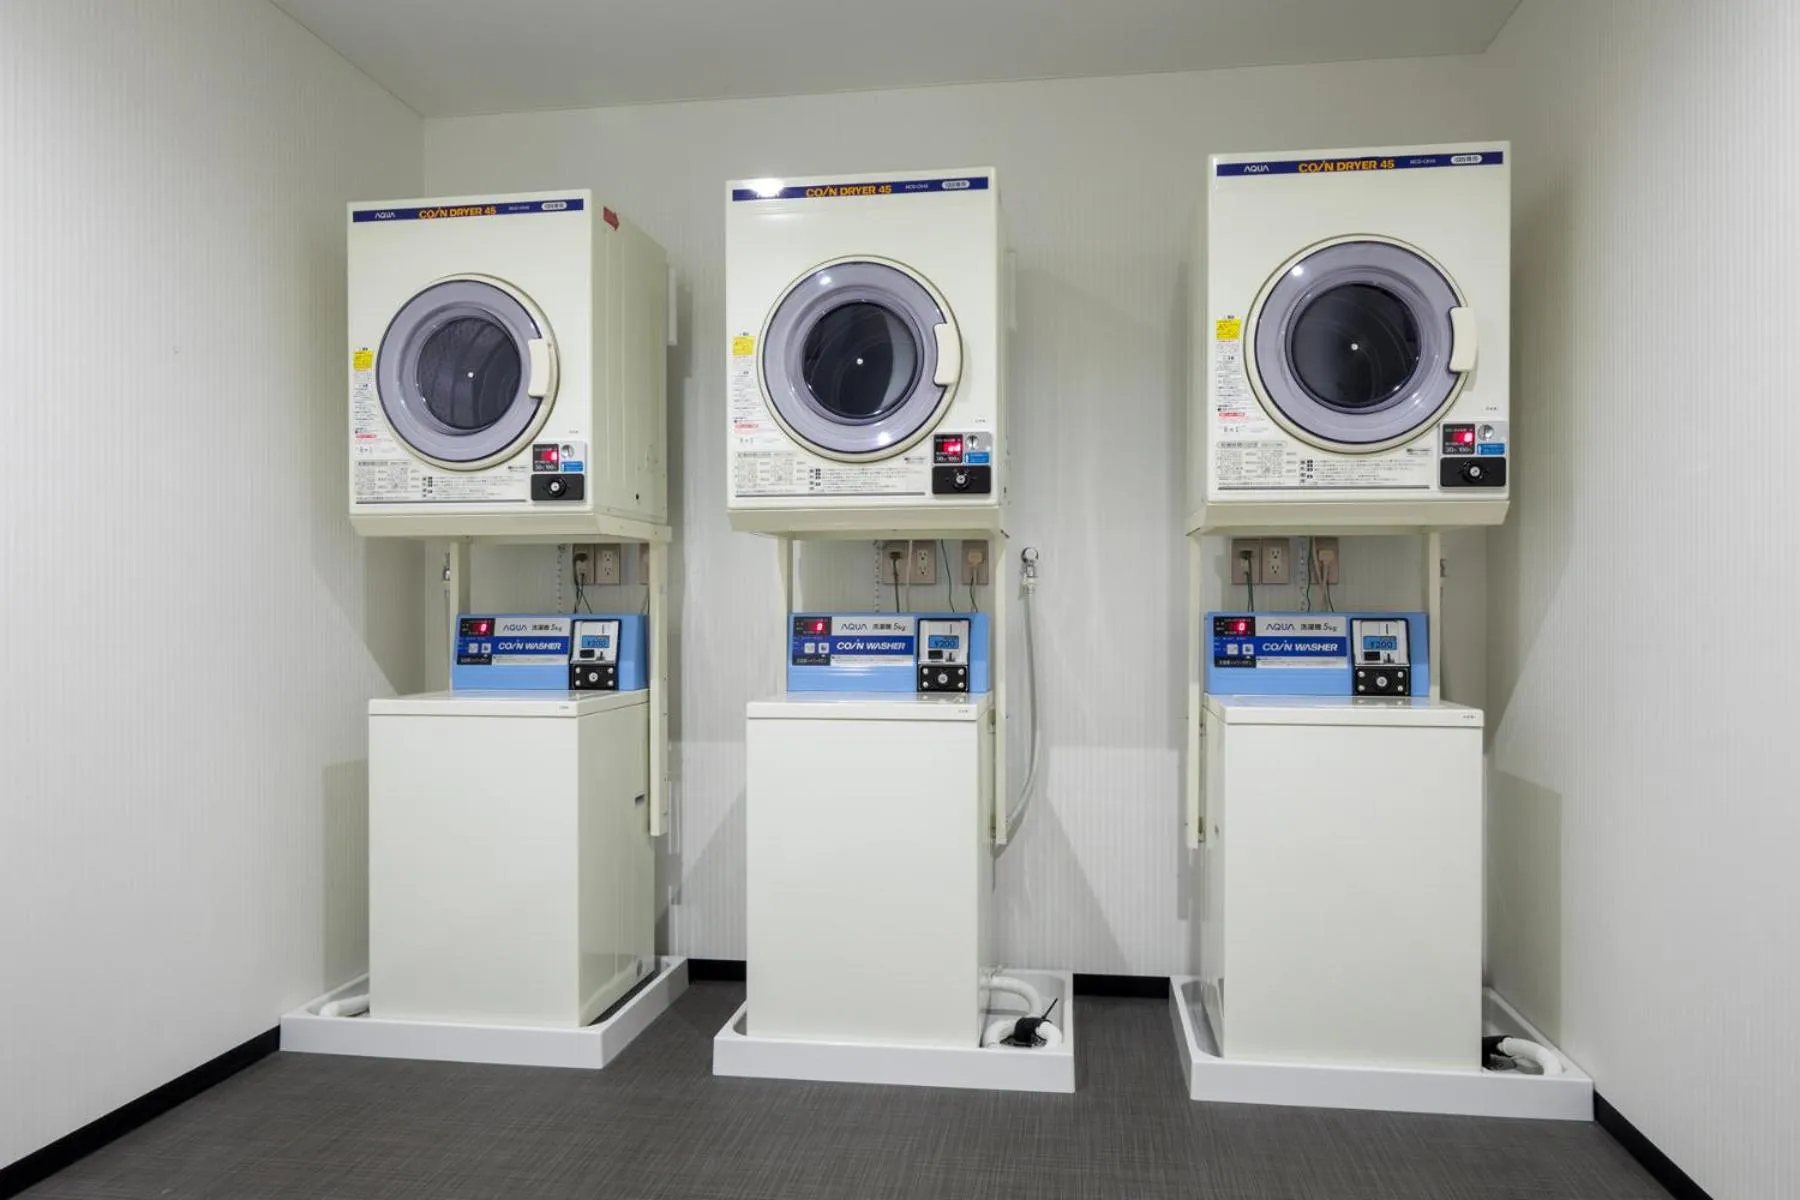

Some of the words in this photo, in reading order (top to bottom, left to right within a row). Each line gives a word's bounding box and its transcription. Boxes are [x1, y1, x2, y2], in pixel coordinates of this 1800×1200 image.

[1243, 164, 1270, 173] AQUA
[1336, 159, 1377, 172] DRYER
[1380, 159, 1395, 170] 45
[839, 185, 876, 196] DRYER
[878, 184, 893, 194] 45
[374, 211, 396, 219] AQUA
[449, 206, 483, 217] DRYER
[483, 205, 497, 215] 45
[502, 623, 528, 632] AQUA
[550, 624, 563, 632] 5kg
[840, 623, 868, 631] AQUA
[893, 623, 906, 632] 5kg
[1265, 623, 1295, 631] AQUA
[1323, 623, 1338, 632] 5kg
[524, 642, 562, 650] WASHER
[865, 642, 906, 650] WASHER
[1294, 643, 1338, 652] WASHER
